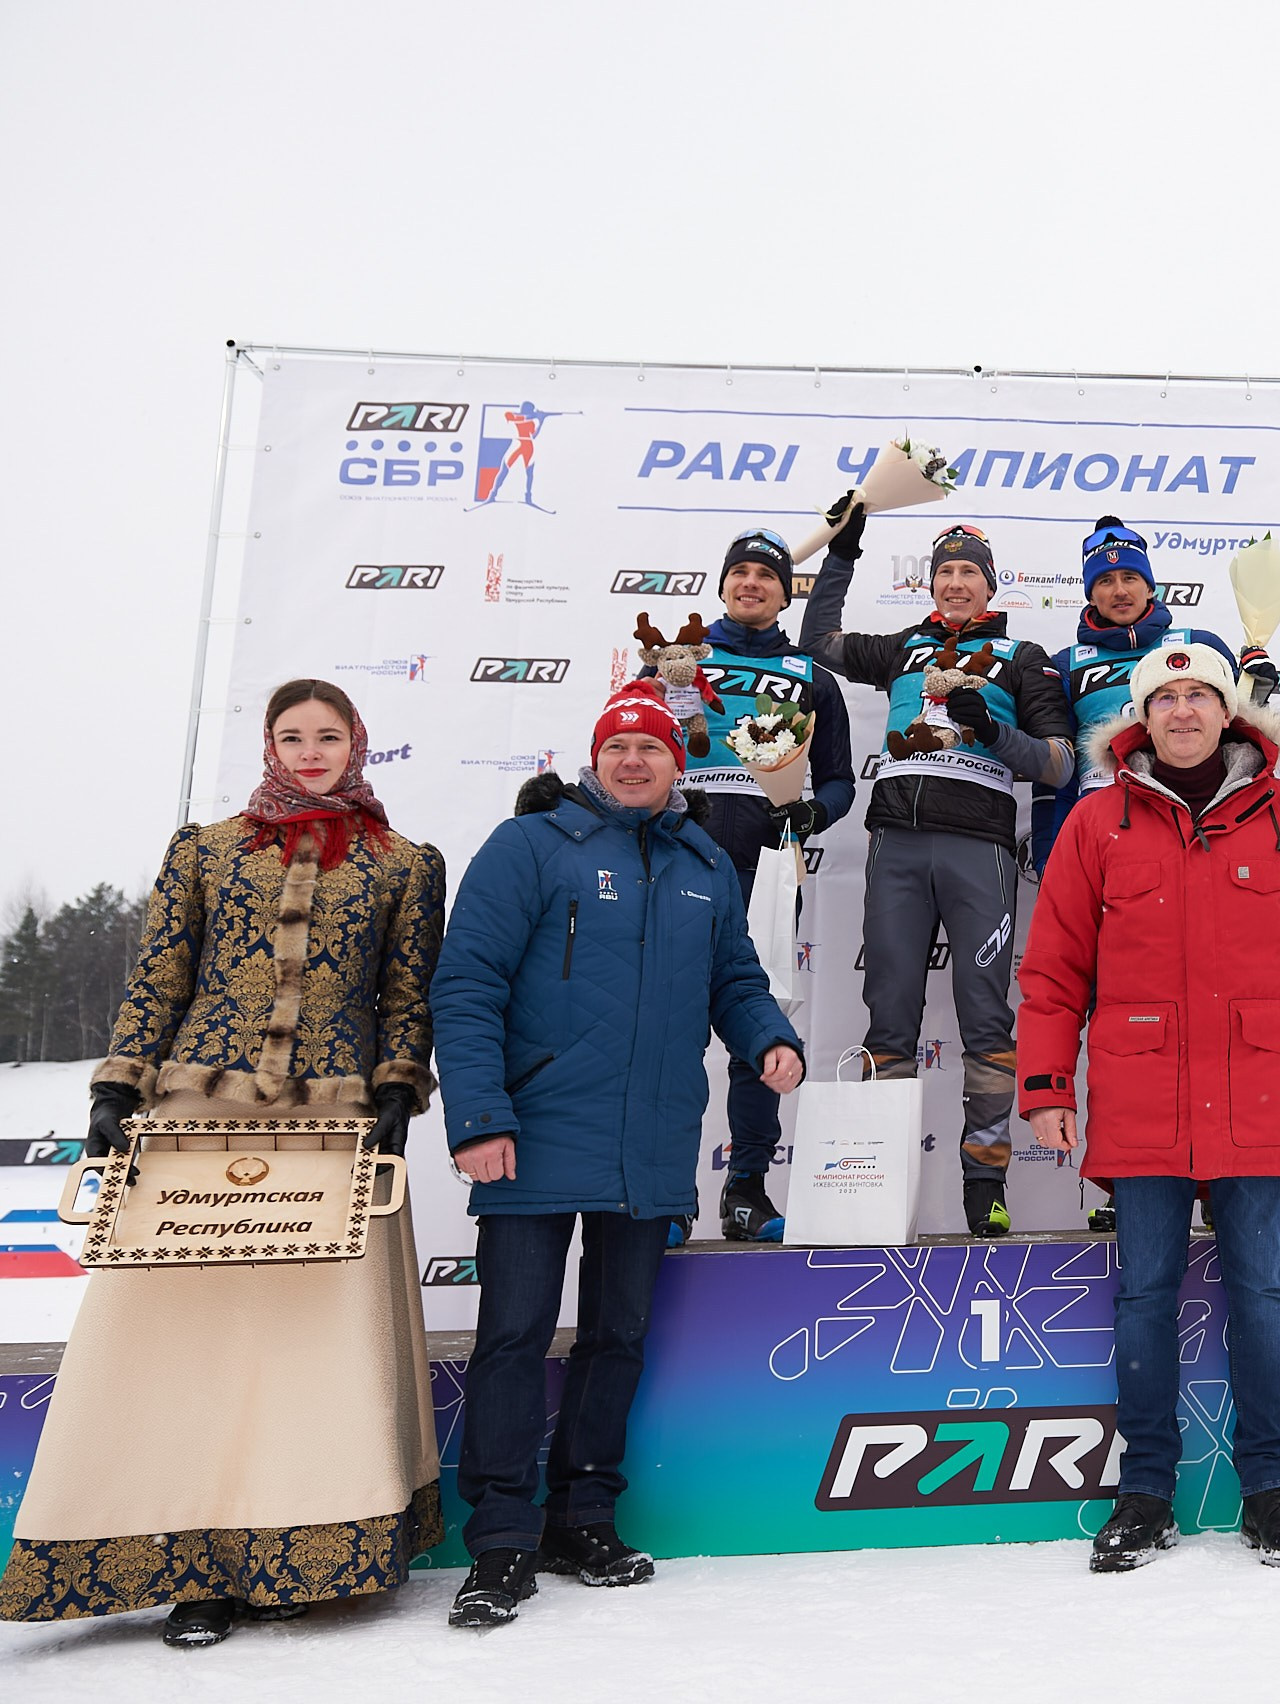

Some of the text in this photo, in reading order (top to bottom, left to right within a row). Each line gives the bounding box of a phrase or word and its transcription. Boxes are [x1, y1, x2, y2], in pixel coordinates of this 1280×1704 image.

[349, 404, 465, 431] PARI
[339, 457, 464, 487] СБР
[637, 440, 800, 482] PARI
[836, 445, 1256, 494] ЧМПИОНАТ
[747, 541, 783, 560] PARI
[348, 565, 442, 588] PARI
[614, 572, 704, 593] PARI
[473, 659, 567, 682] PARI
[689, 772, 758, 785] ЧЕМПИОН
[956, 758, 1005, 778] РОССИИ
[156, 1188, 325, 1208] Удмуртская
[155, 1218, 313, 1238] Республика
[970, 1300, 1000, 1362] 1
